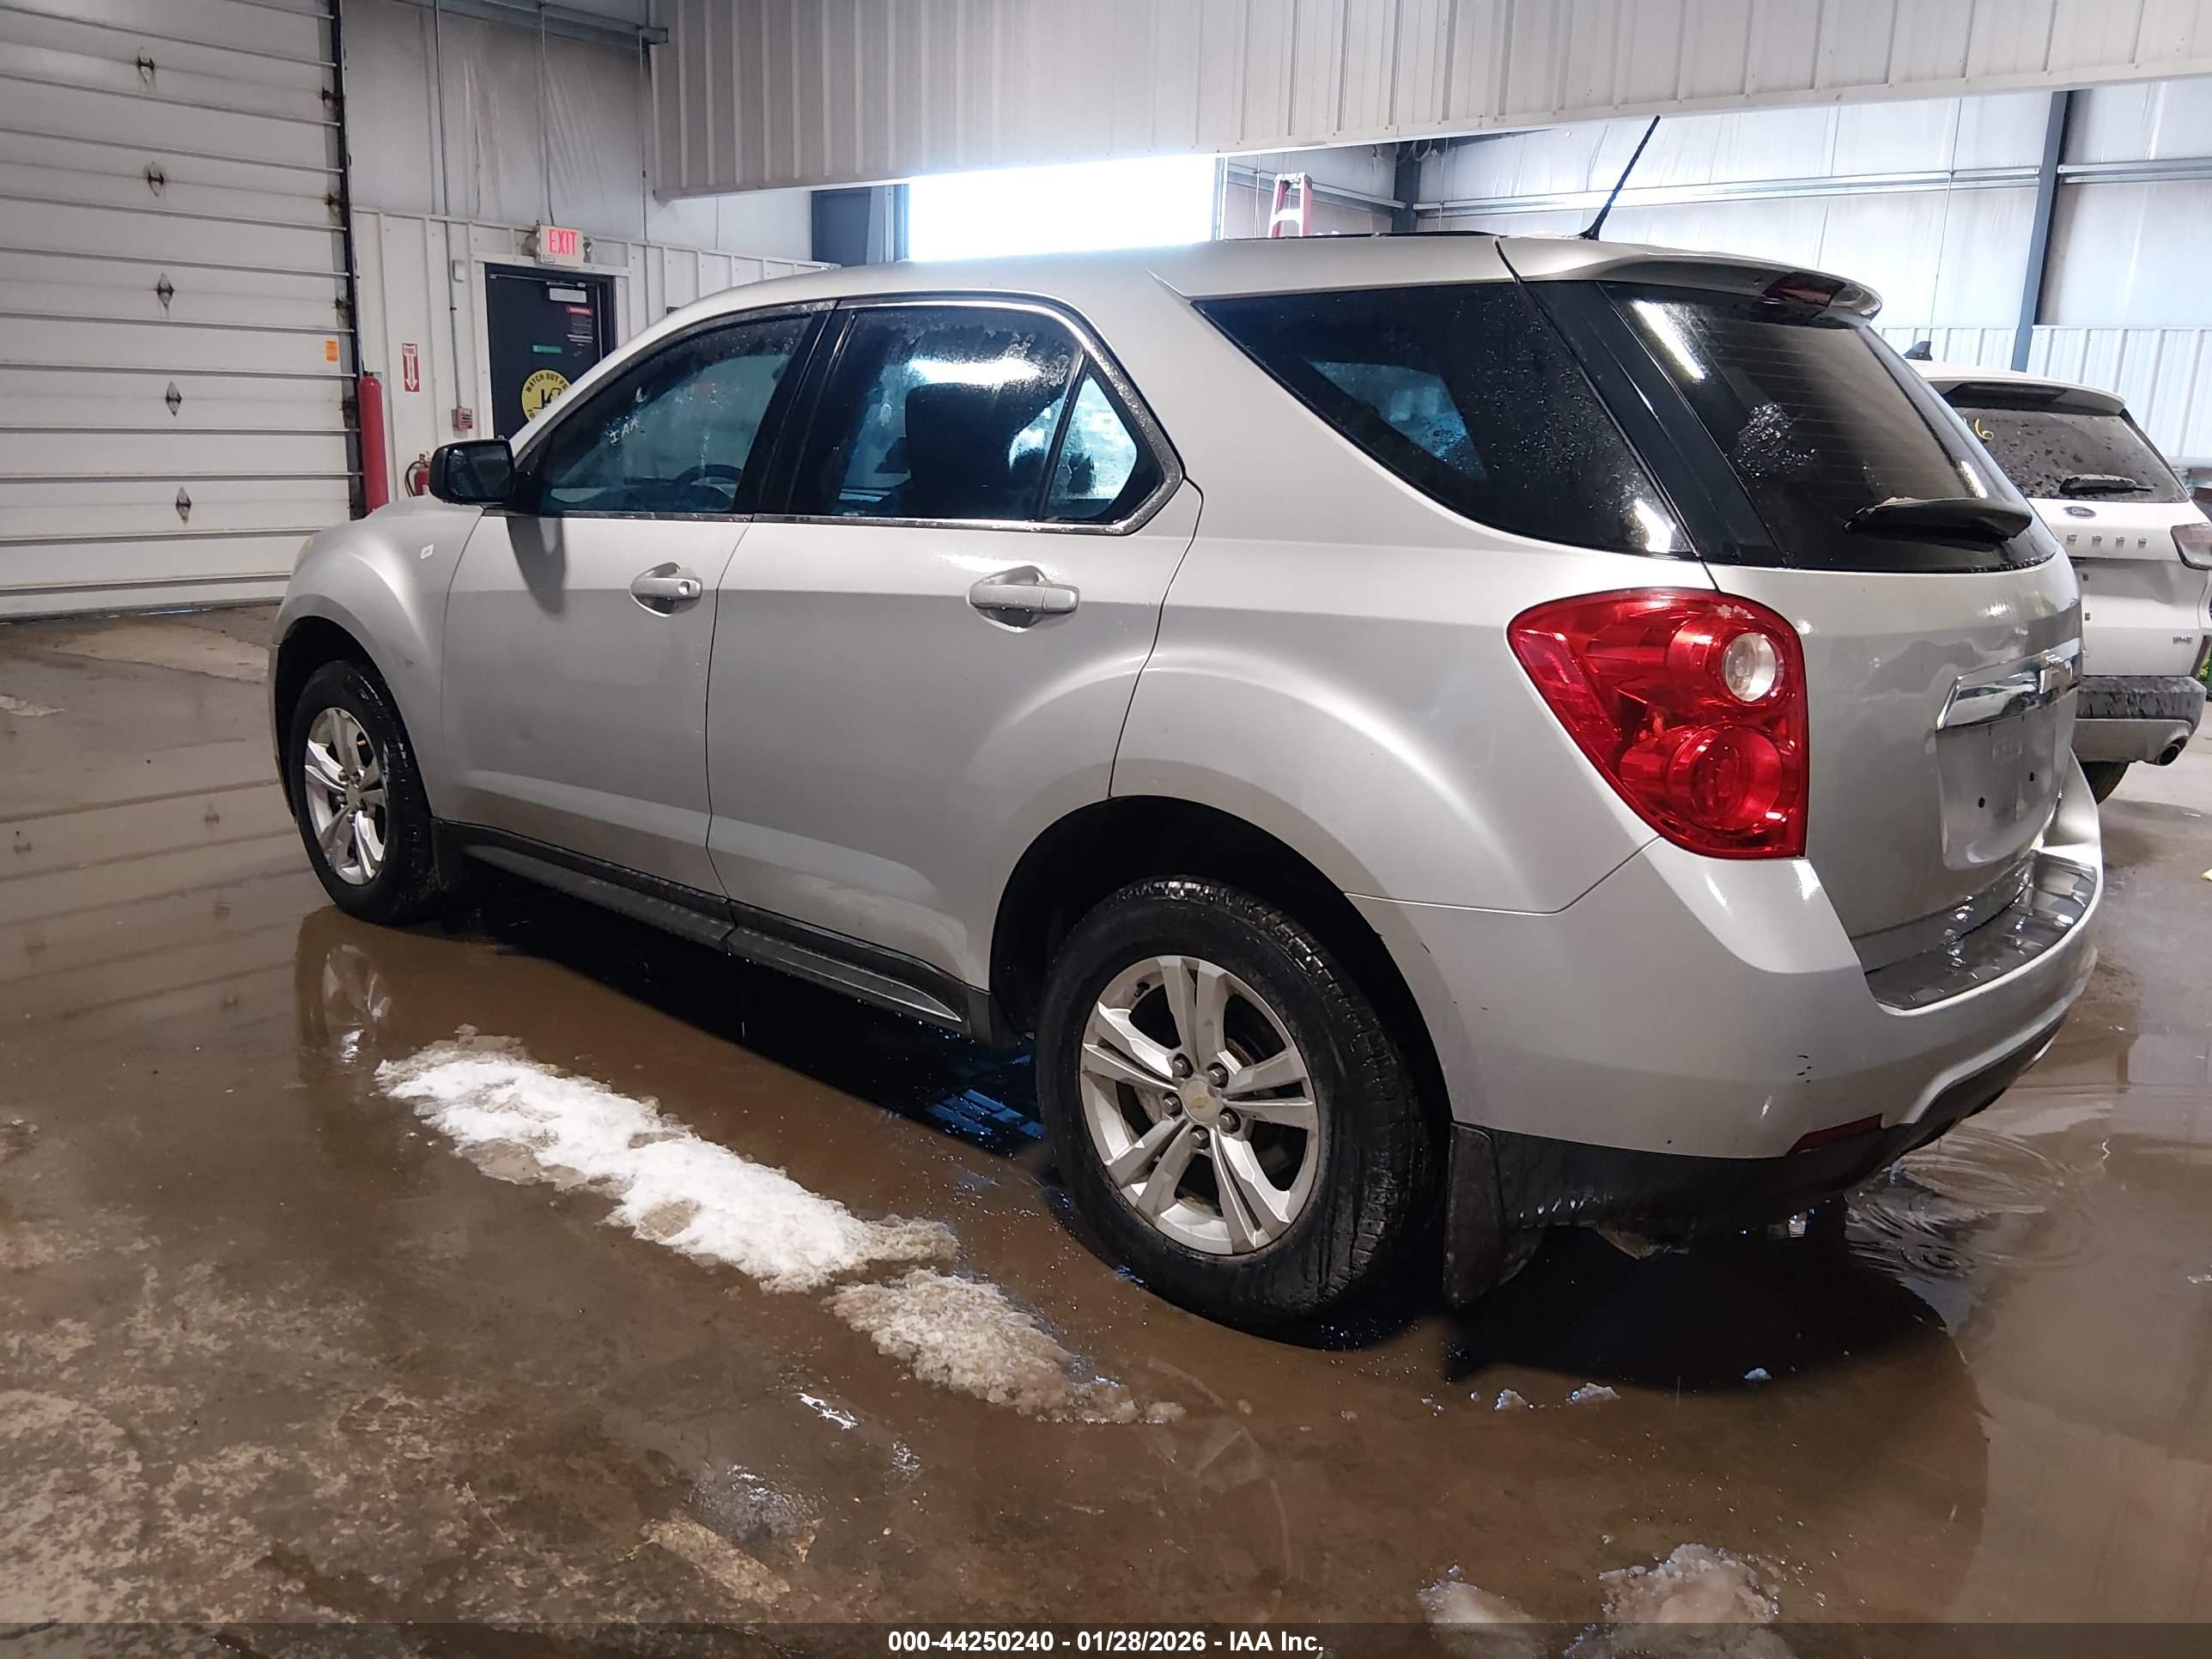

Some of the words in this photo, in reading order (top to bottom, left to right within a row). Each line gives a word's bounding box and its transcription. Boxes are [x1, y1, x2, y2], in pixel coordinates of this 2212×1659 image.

[549, 228, 578, 255] EXIT
[526, 372, 545, 393] WATCH
[545, 372, 560, 383] OUT
[559, 379, 568, 392] FO
